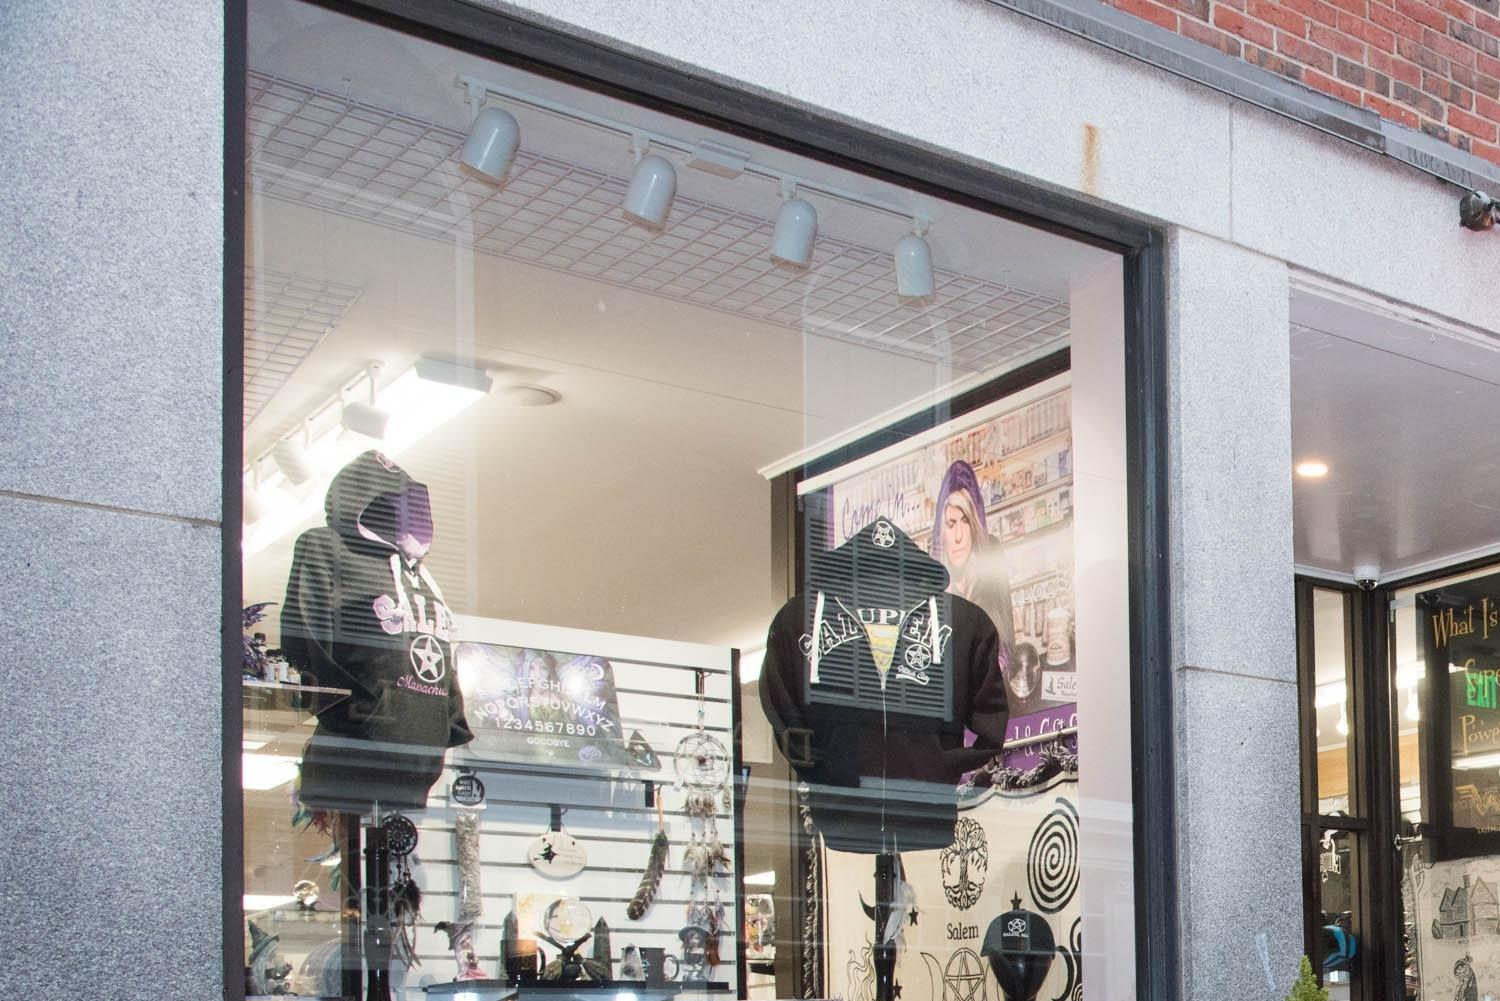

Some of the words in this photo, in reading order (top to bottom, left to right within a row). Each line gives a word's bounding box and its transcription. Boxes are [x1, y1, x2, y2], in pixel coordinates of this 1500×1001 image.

[1432, 604, 1475, 648] What
[1480, 597, 1498, 640] Is
[496, 718, 596, 737] 1234567890
[946, 922, 979, 940] Salem
